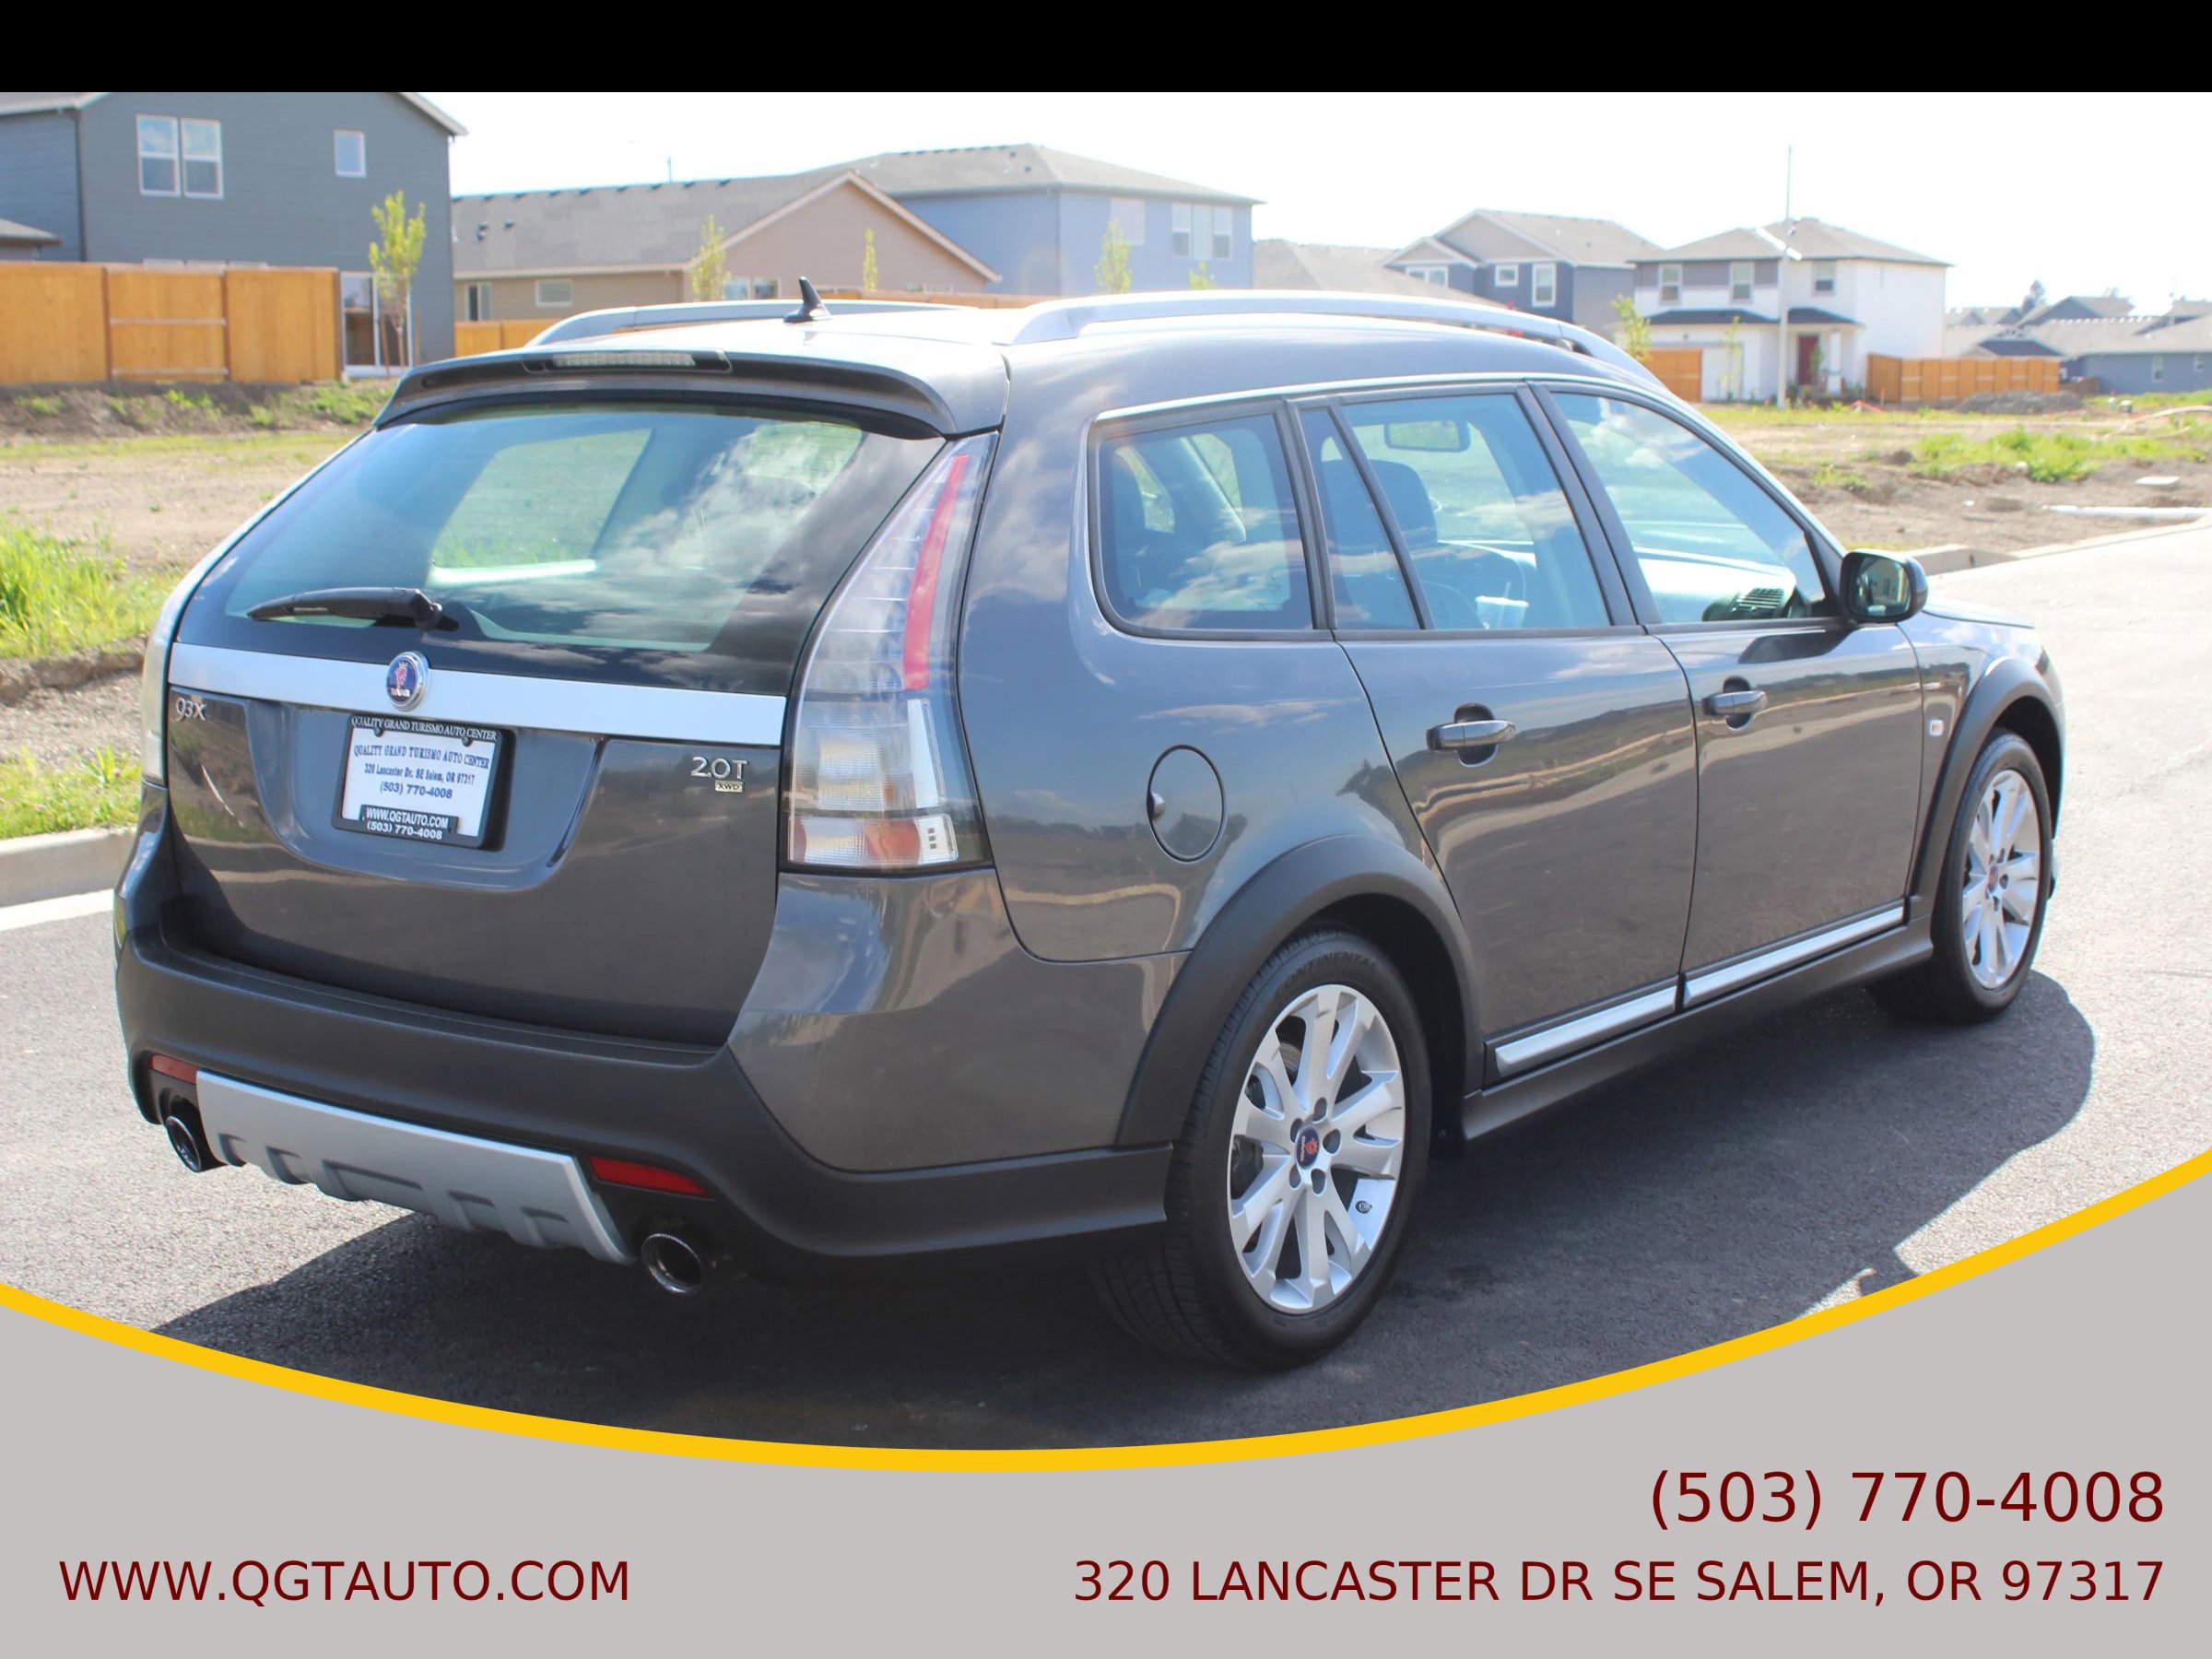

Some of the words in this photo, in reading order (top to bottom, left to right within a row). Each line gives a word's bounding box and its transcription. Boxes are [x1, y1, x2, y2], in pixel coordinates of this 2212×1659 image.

[351, 716, 383, 728] QUALITY
[383, 719, 410, 730] GRAND
[411, 721, 443, 735] TURISMO
[443, 725, 466, 736] AUTO
[466, 727, 497, 740] CENTER
[354, 745, 382, 758] QUALITY
[384, 746, 406, 757] GRAND
[409, 747, 441, 761] TURISMO
[442, 751, 463, 762] AUTO
[464, 754, 490, 770] CENTER
[691, 756, 748, 780] 2.0T
[364, 763, 375, 774] 320
[376, 764, 403, 777] Lancaster
[416, 769, 424, 779] SE
[425, 769, 444, 783] Salem,
[446, 772, 455, 782] OR
[456, 772, 476, 785] 97317
[380, 782, 404, 794] (503)
[406, 783, 453, 799] 770-4008
[716, 782, 741, 791] XWD
[366, 806, 449, 829] WWW.QGTAUTO.COM
[367, 820, 393, 833] (503)
[395, 825, 442, 841] 770-4008
